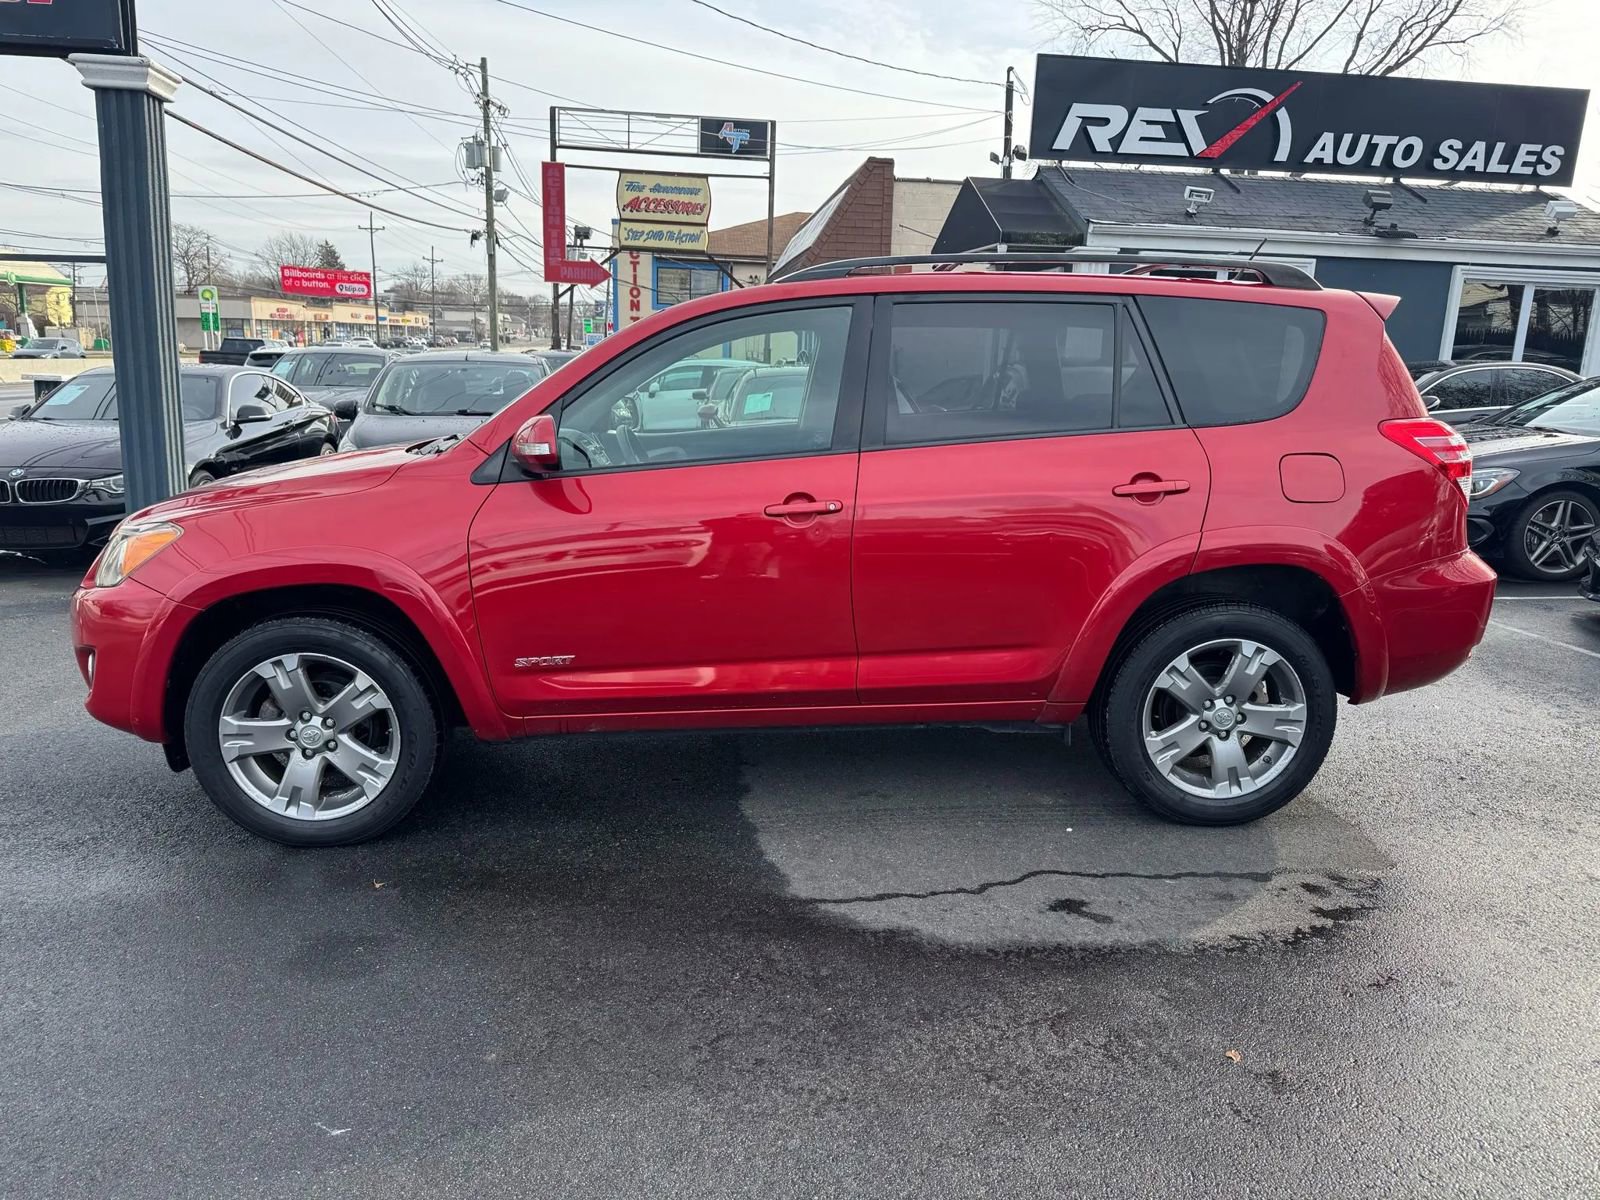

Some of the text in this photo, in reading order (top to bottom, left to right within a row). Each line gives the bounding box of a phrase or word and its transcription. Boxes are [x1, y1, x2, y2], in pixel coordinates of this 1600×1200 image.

[1303, 131, 1424, 168] AUTO
[1433, 138, 1565, 176] SALES
[622, 196, 706, 216] ACCESSORIES
[283, 268, 325, 279] Billboards
[326, 272, 335, 280] at
[284, 279, 292, 287] of
[301, 279, 331, 289] button.
[514, 655, 576, 667] SPORT
